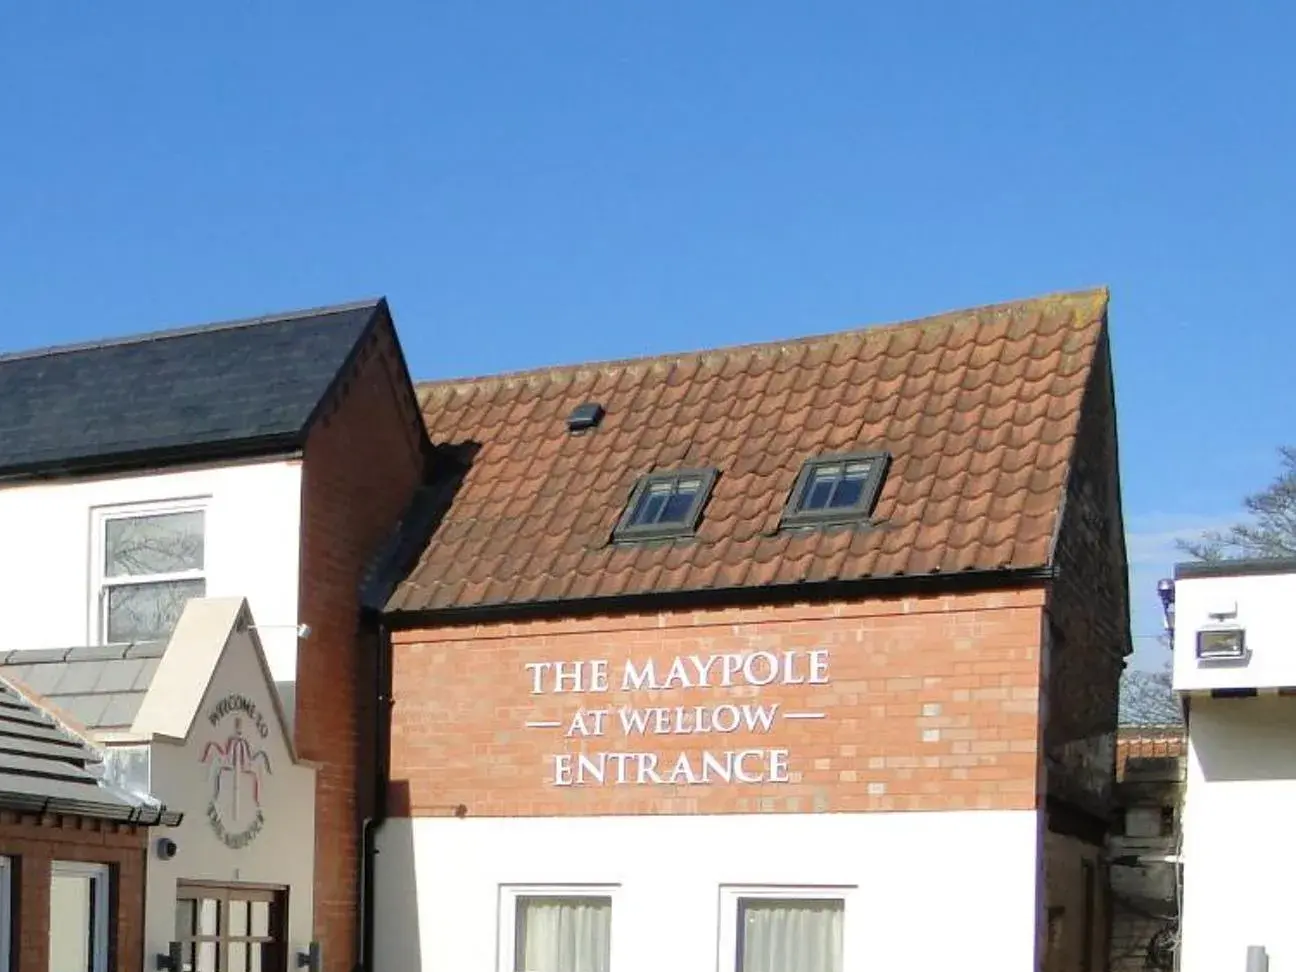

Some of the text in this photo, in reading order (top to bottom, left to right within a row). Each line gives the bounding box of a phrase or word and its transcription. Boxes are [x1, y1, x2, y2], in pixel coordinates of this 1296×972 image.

[525, 649, 831, 695] THE MAYPOLE
[564, 703, 780, 737] AT WELLOW
[553, 748, 790, 786] ENTRANCE
